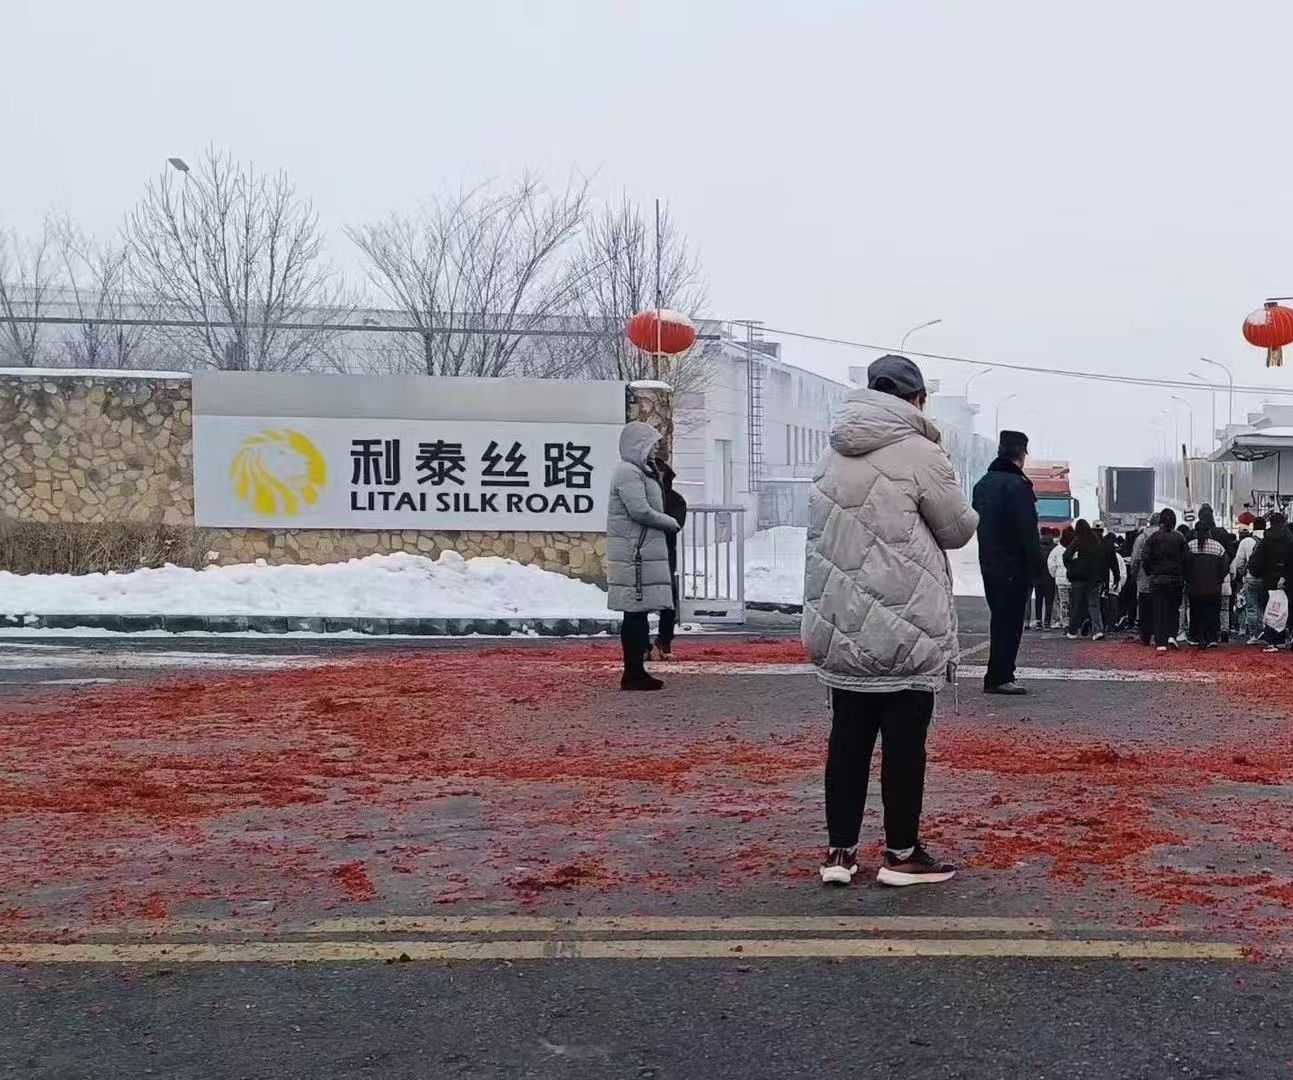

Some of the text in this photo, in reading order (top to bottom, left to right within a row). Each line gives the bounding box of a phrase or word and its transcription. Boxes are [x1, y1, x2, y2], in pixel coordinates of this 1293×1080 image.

[350, 439, 595, 489] 利泰丝路
[350, 491, 594, 514] LITAI SILK ROAD
